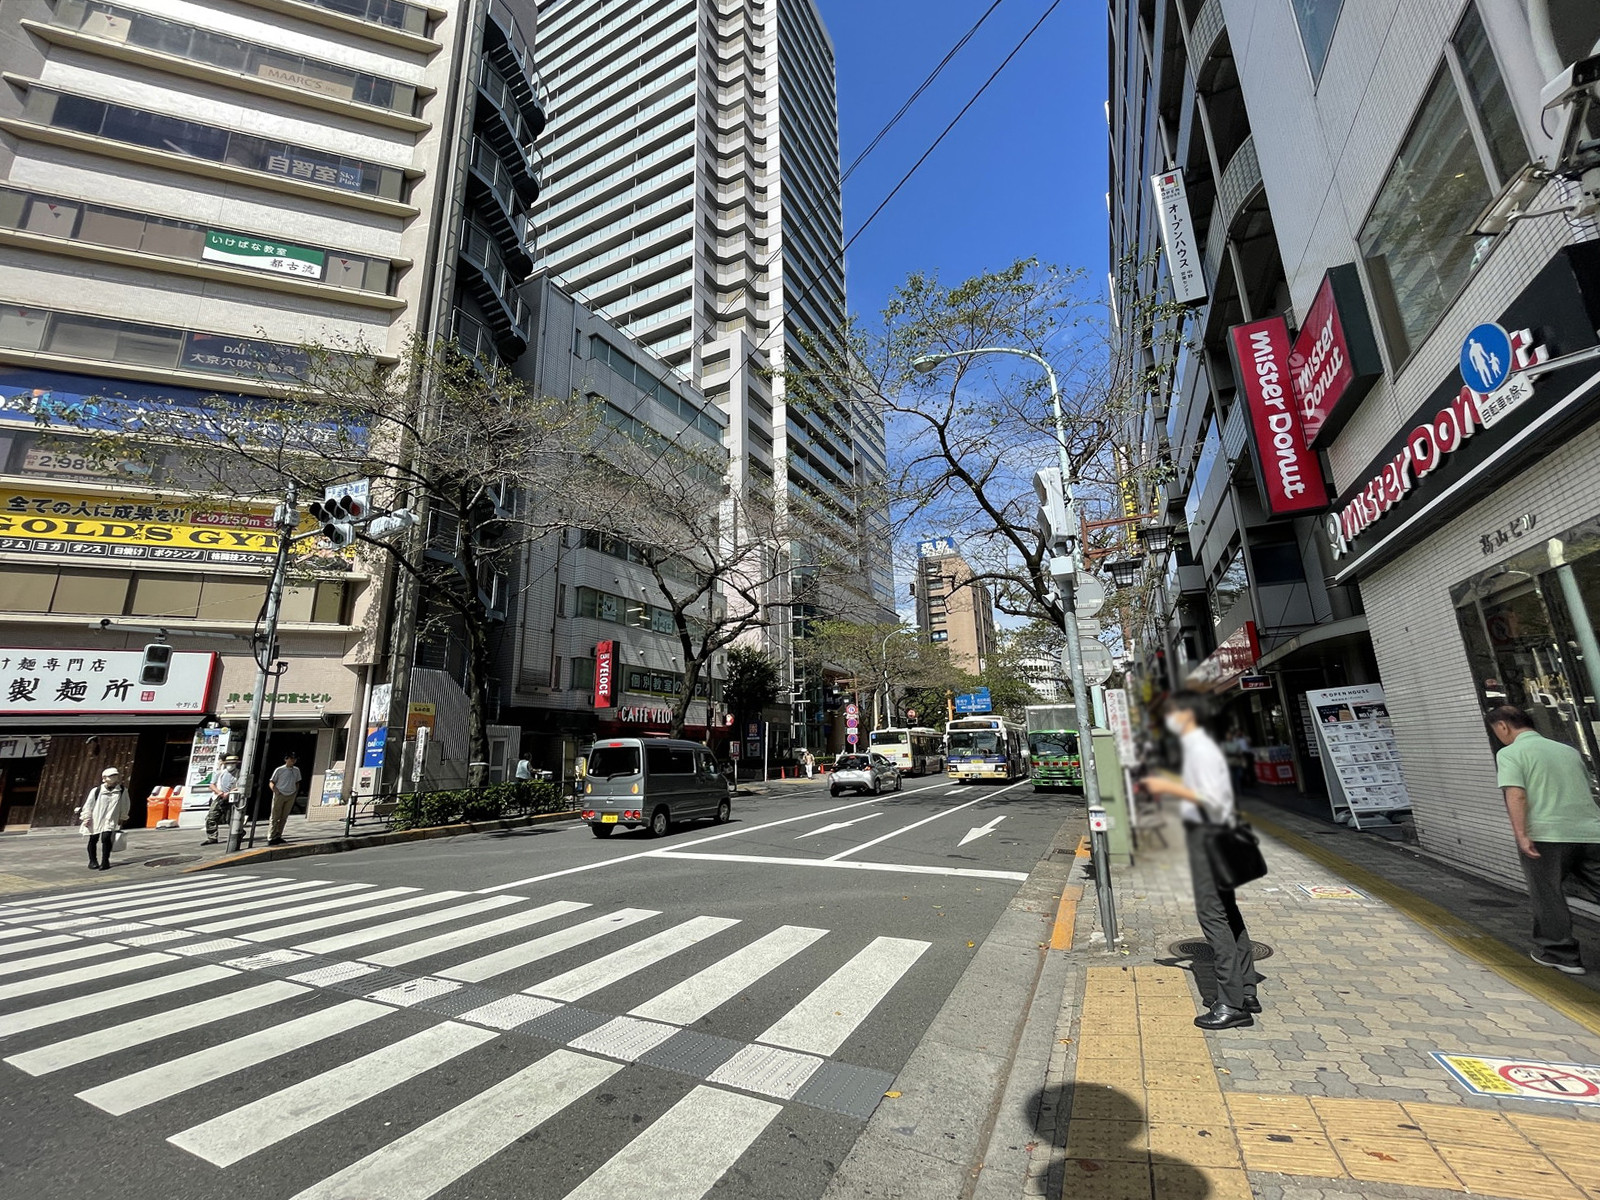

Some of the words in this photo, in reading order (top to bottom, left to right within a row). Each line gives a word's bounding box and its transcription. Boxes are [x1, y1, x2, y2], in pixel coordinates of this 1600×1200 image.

[268, 69, 321, 90] MAARC'S
[267, 156, 338, 183] 自習室
[340, 170, 355, 180] Sky
[339, 177, 360, 187] Place
[1161, 188, 1180, 196] OPEN
[1162, 192, 1181, 200] HOUSE
[212, 235, 288, 256] いけばな教室
[1169, 204, 1189, 269] オープンハウス
[270, 258, 315, 275] 都古流
[1482, 382, 1528, 423] 自転車を除く
[37, 542, 61, 551] ヨガ
[73, 544, 102, 553] ダンス
[114, 546, 144, 556] 日焼け
[154, 549, 200, 559] ボクシング
[211, 552, 274, 563] 格闘技スクール
[599, 660, 610, 695] VELOCE
[7, 678, 134, 703] 製麺所
[227, 693, 240, 702] JR
